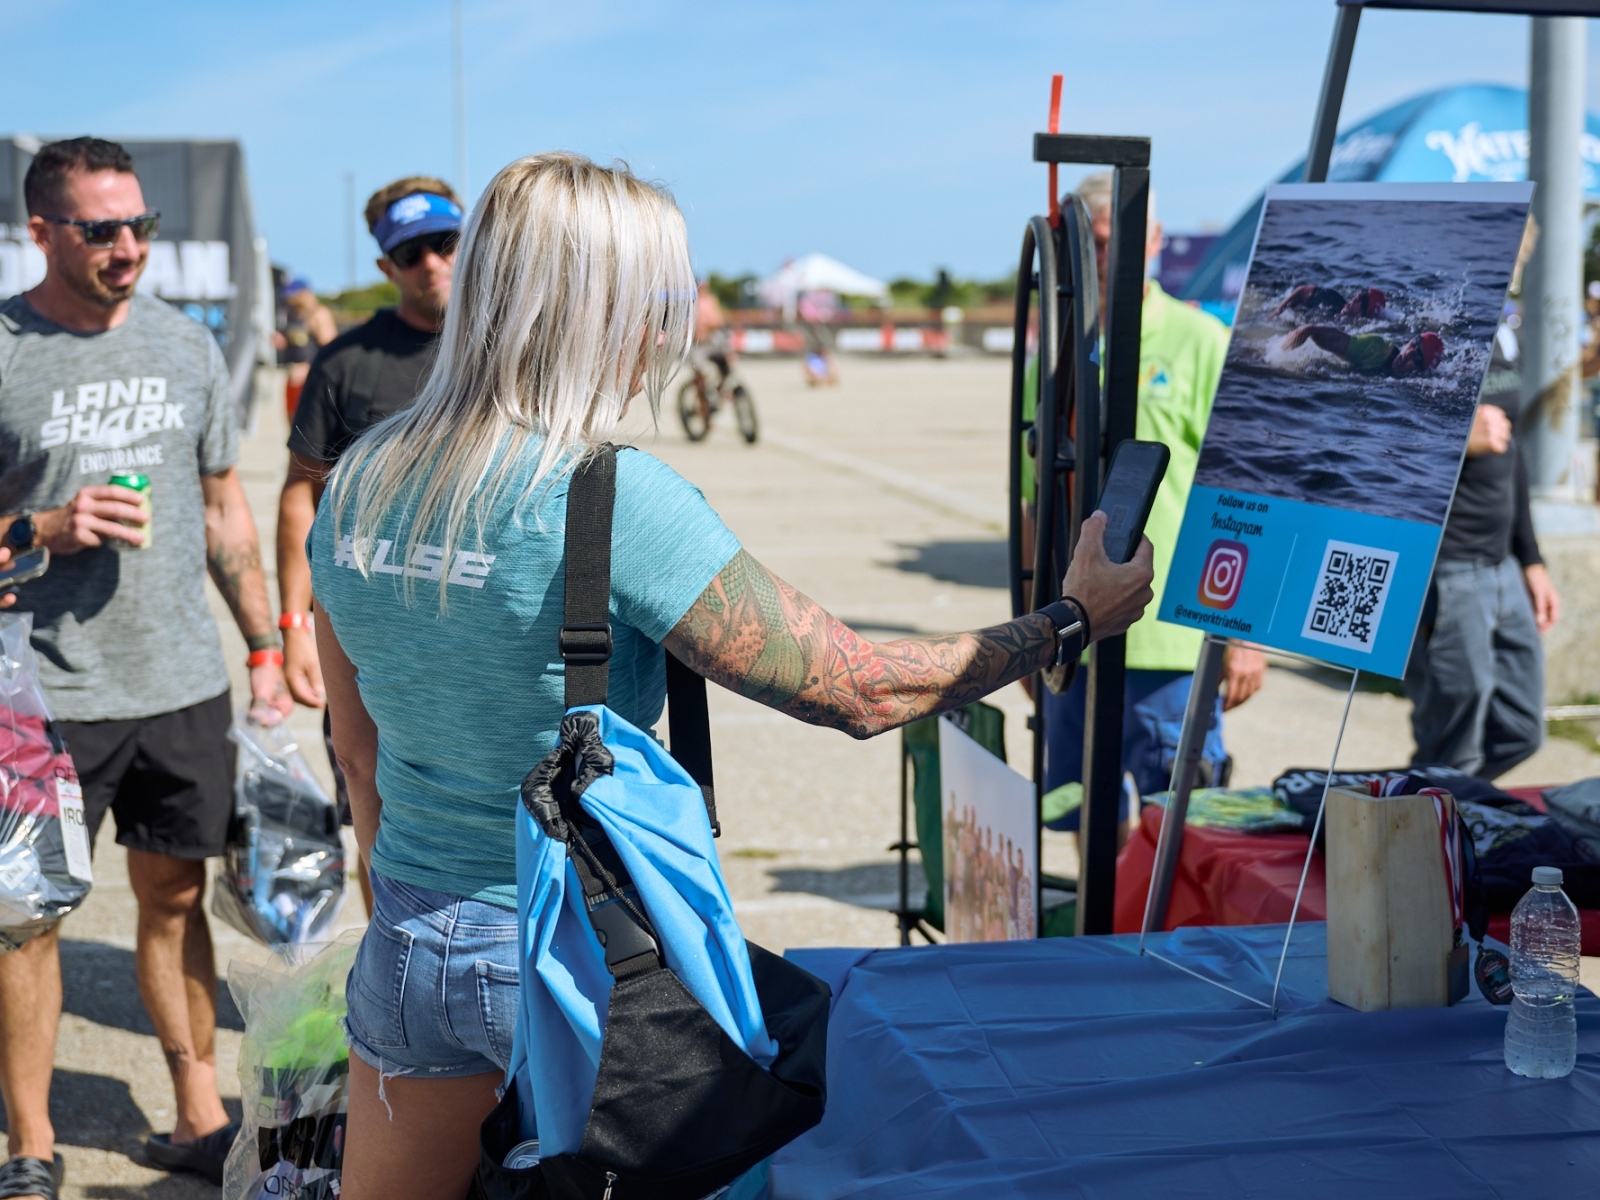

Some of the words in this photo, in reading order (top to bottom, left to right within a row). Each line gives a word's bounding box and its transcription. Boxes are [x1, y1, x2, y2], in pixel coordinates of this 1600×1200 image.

[51, 376, 167, 418] LAND
[39, 402, 186, 450] SHARK
[79, 444, 165, 475] ENDURANCE
[1217, 493, 1246, 510] Follow
[1246, 501, 1257, 511] us
[1257, 503, 1269, 513] on
[1211, 511, 1264, 540] Instagram
[1174, 604, 1252, 633] @newyorktriathlon
